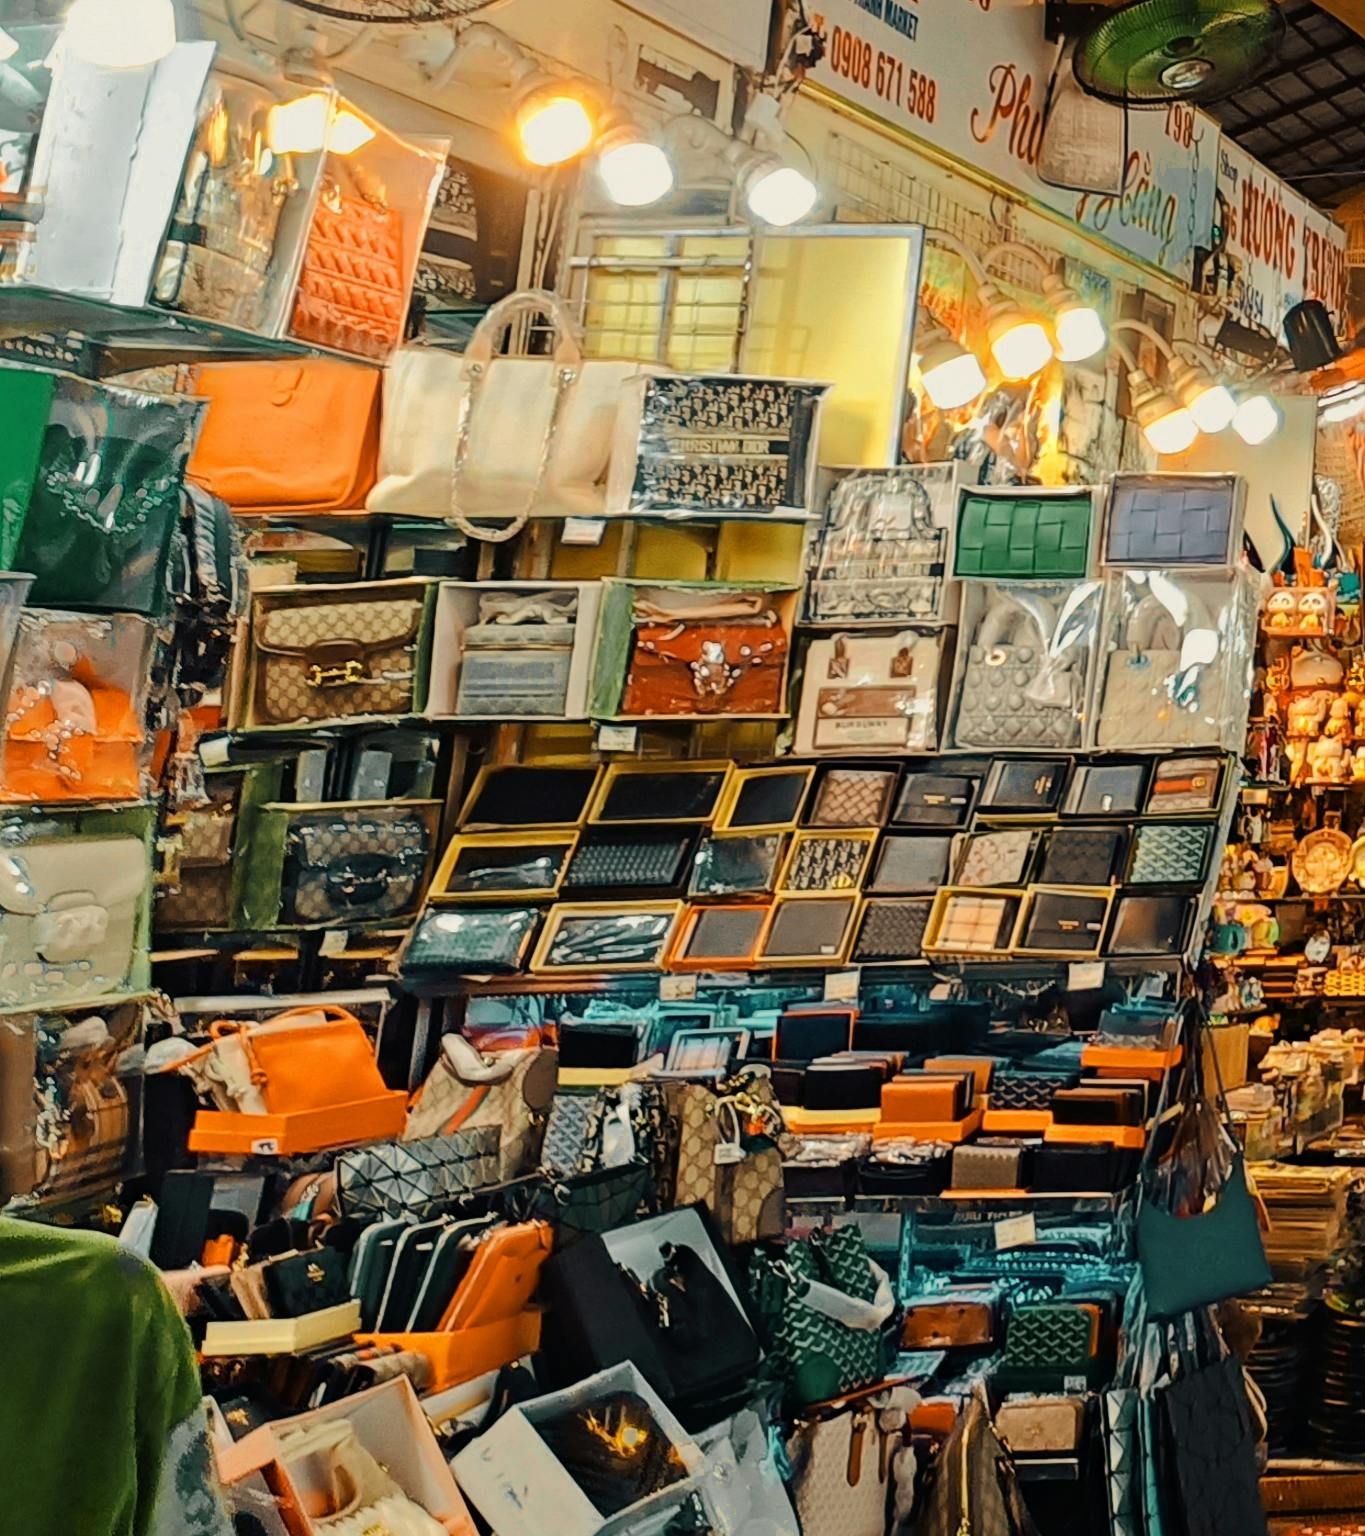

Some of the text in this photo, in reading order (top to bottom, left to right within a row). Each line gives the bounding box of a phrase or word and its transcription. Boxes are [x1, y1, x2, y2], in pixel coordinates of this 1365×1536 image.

[829, 25, 873, 90] 0908
[875, 50, 903, 108] 671
[907, 68, 937, 124] 588
